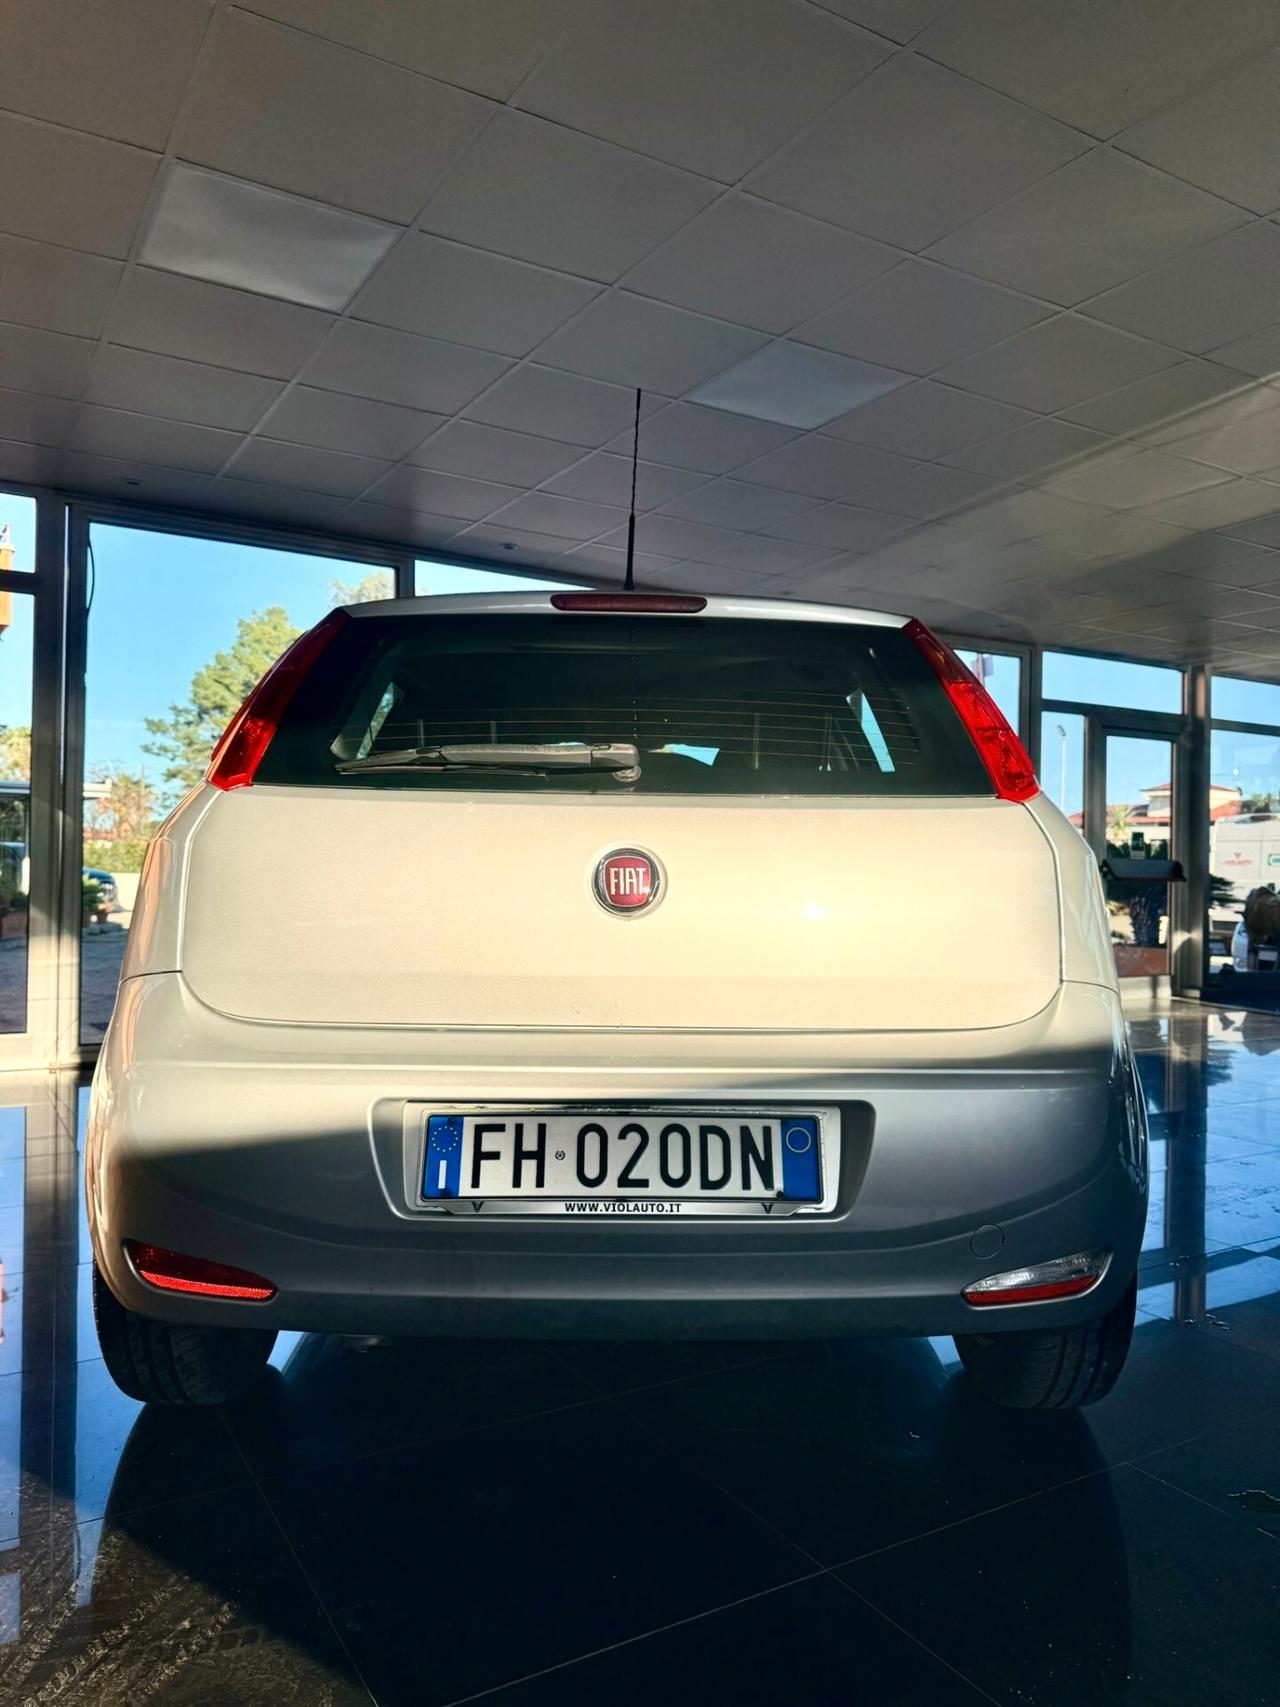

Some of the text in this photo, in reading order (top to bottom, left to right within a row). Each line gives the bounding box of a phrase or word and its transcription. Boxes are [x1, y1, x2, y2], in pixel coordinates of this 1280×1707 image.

[609, 867, 647, 895] FIAT
[471, 1123, 547, 1189] FH
[565, 1203, 682, 1213] WWW.VIOLAUTO.IT
